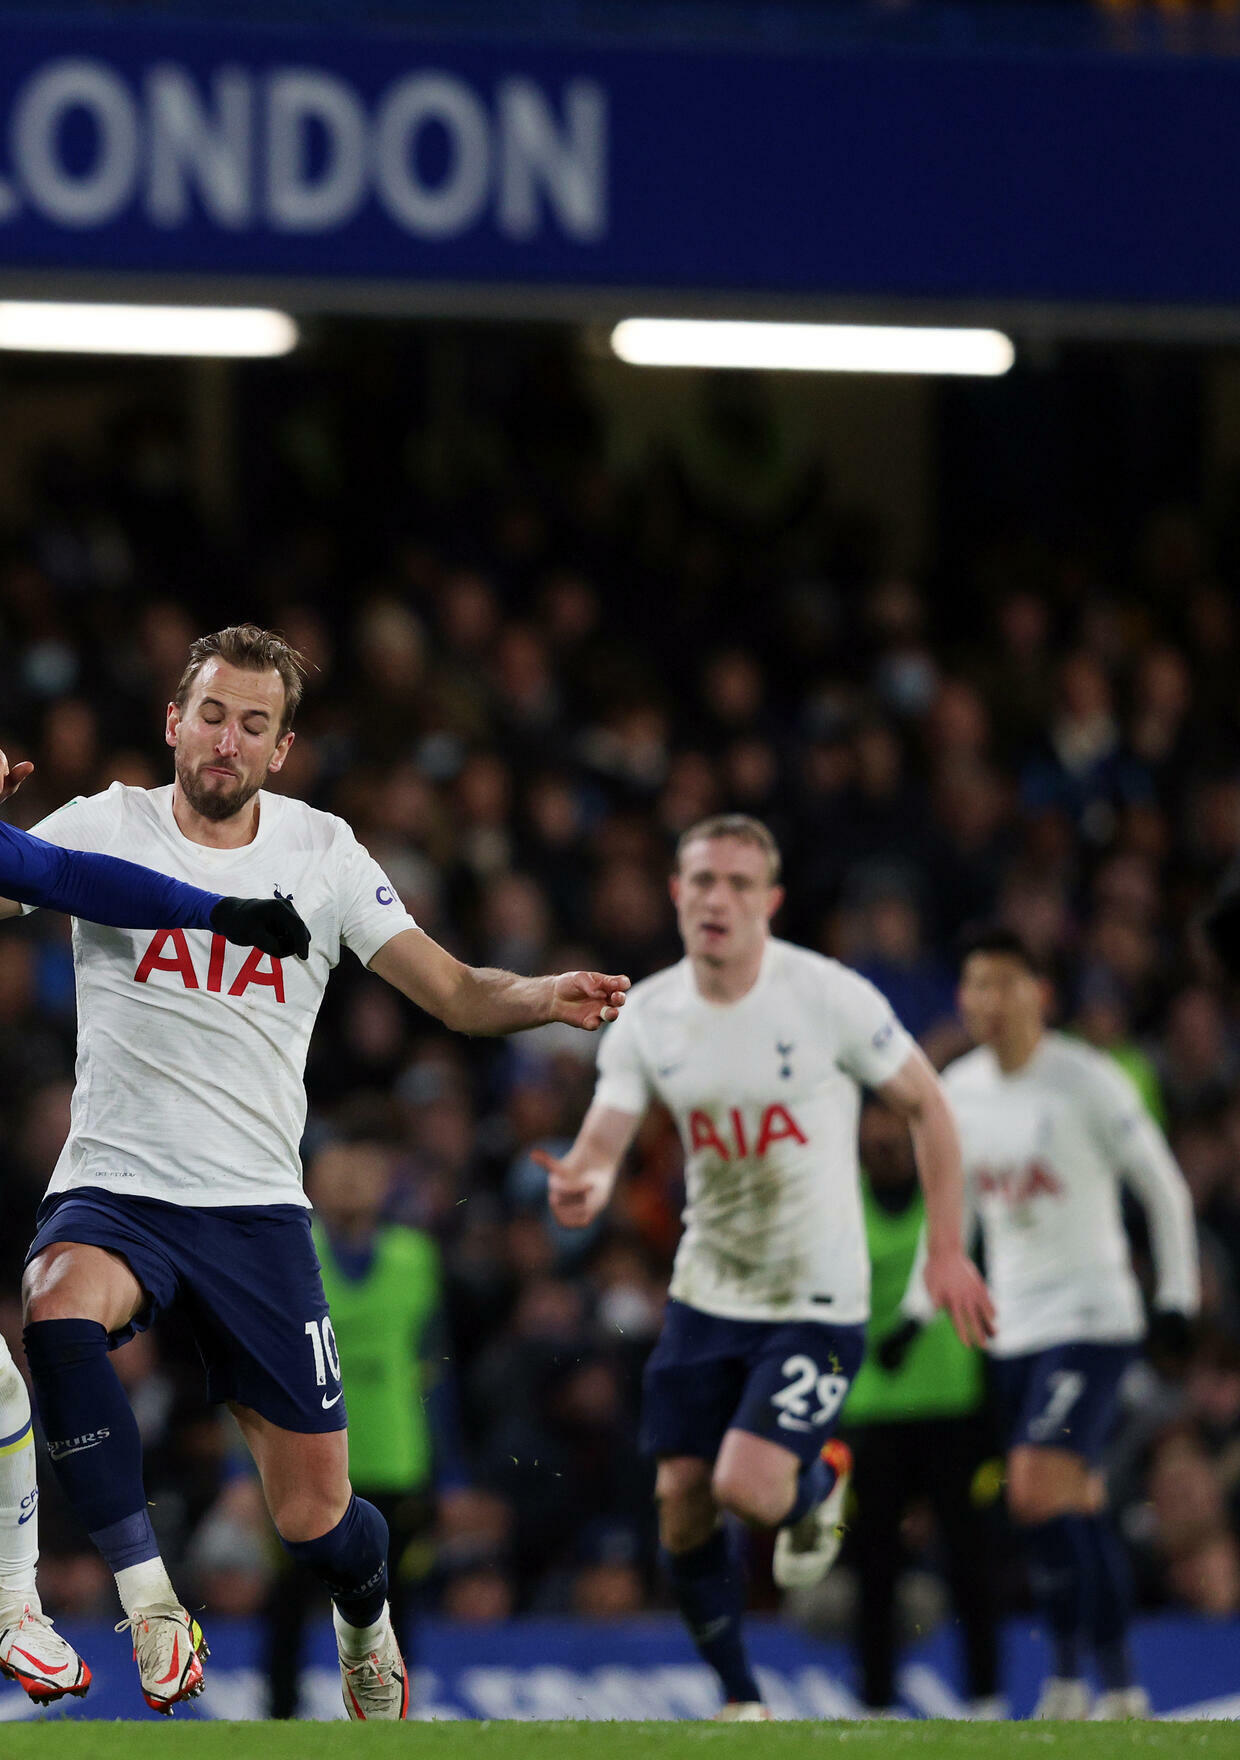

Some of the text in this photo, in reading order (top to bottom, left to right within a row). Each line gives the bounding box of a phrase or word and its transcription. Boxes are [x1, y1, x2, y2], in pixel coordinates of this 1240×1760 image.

[134, 928, 285, 1003] AIA
[688, 1102, 808, 1162] AIA
[305, 1316, 341, 1386] 10
[771, 1354, 849, 1428] 29
[1027, 1369, 1085, 1438] 7
[47, 1427, 111, 1452] SPURS
